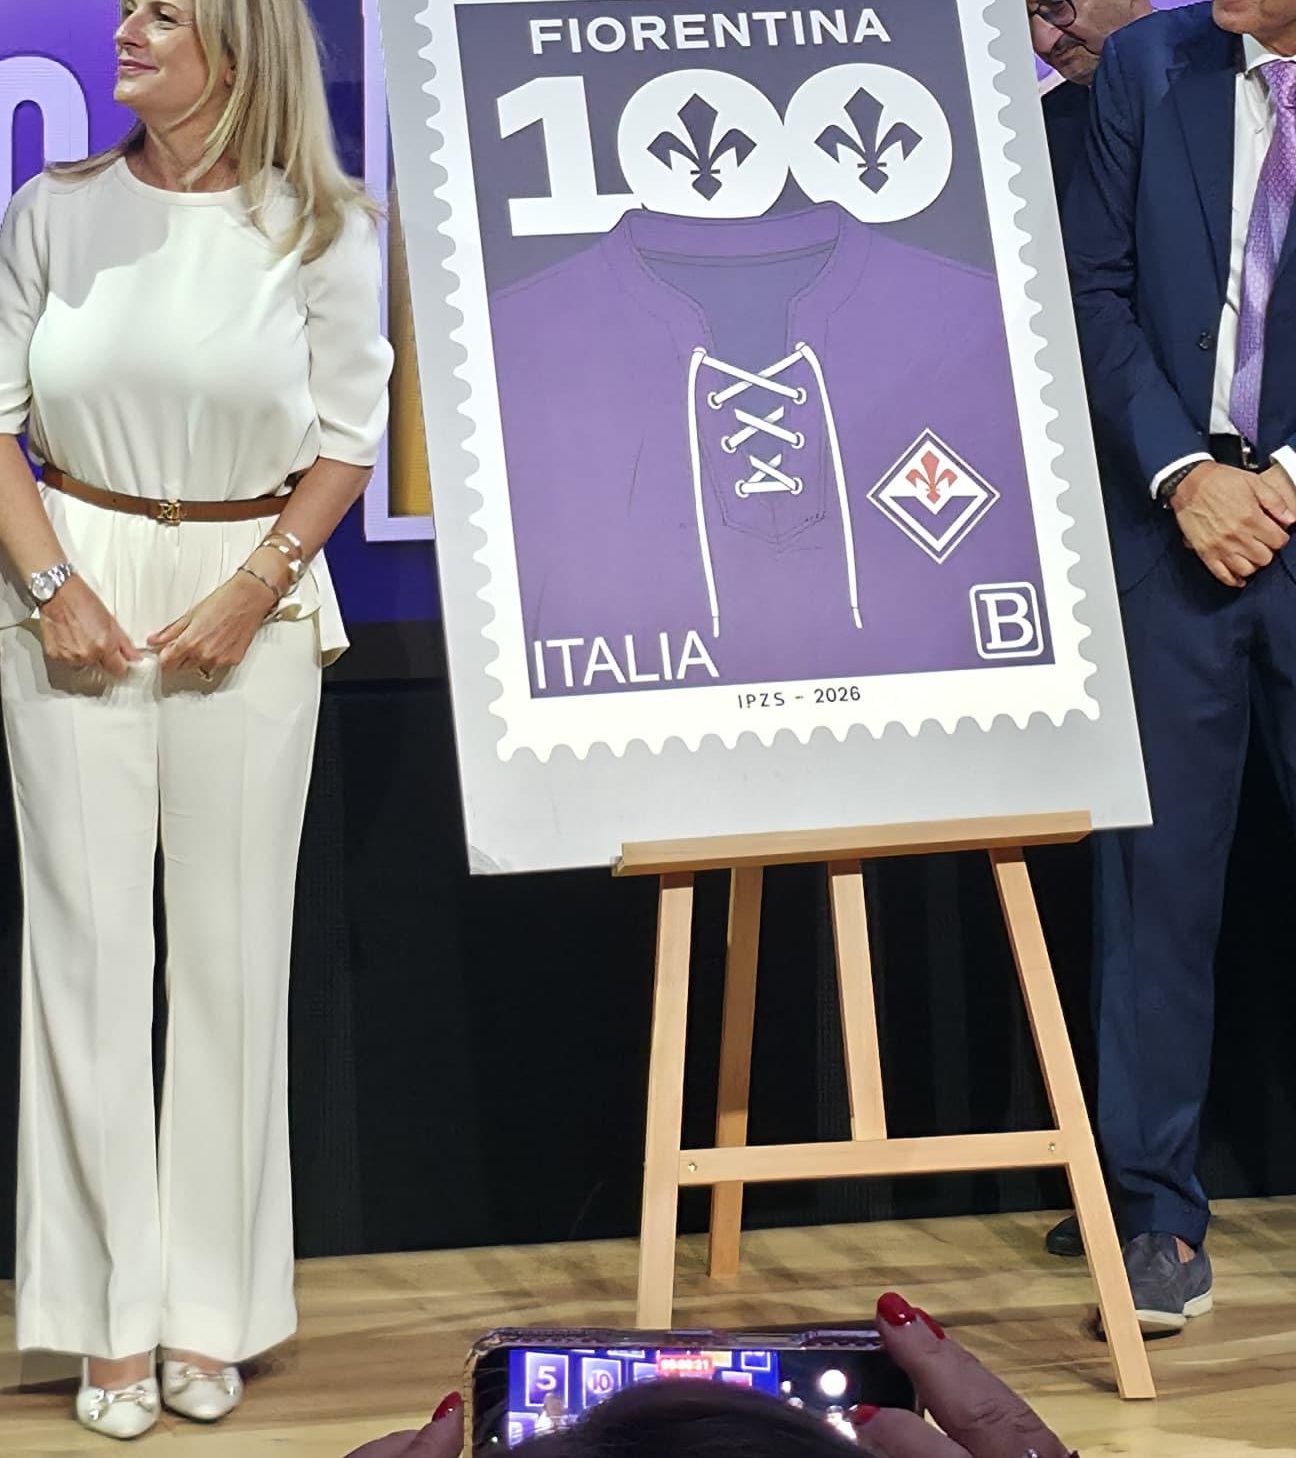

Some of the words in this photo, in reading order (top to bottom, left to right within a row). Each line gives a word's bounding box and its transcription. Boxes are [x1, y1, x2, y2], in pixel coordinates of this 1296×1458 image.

[528, 7, 892, 55] FIORENTINA
[496, 62, 954, 237] 100
[979, 592, 1034, 650] B
[533, 630, 721, 690] ITALIA
[737, 691, 786, 710] IPZS
[814, 685, 861, 704] 2026
[536, 1365, 558, 1391] 5
[591, 1372, 611, 1391] 10
